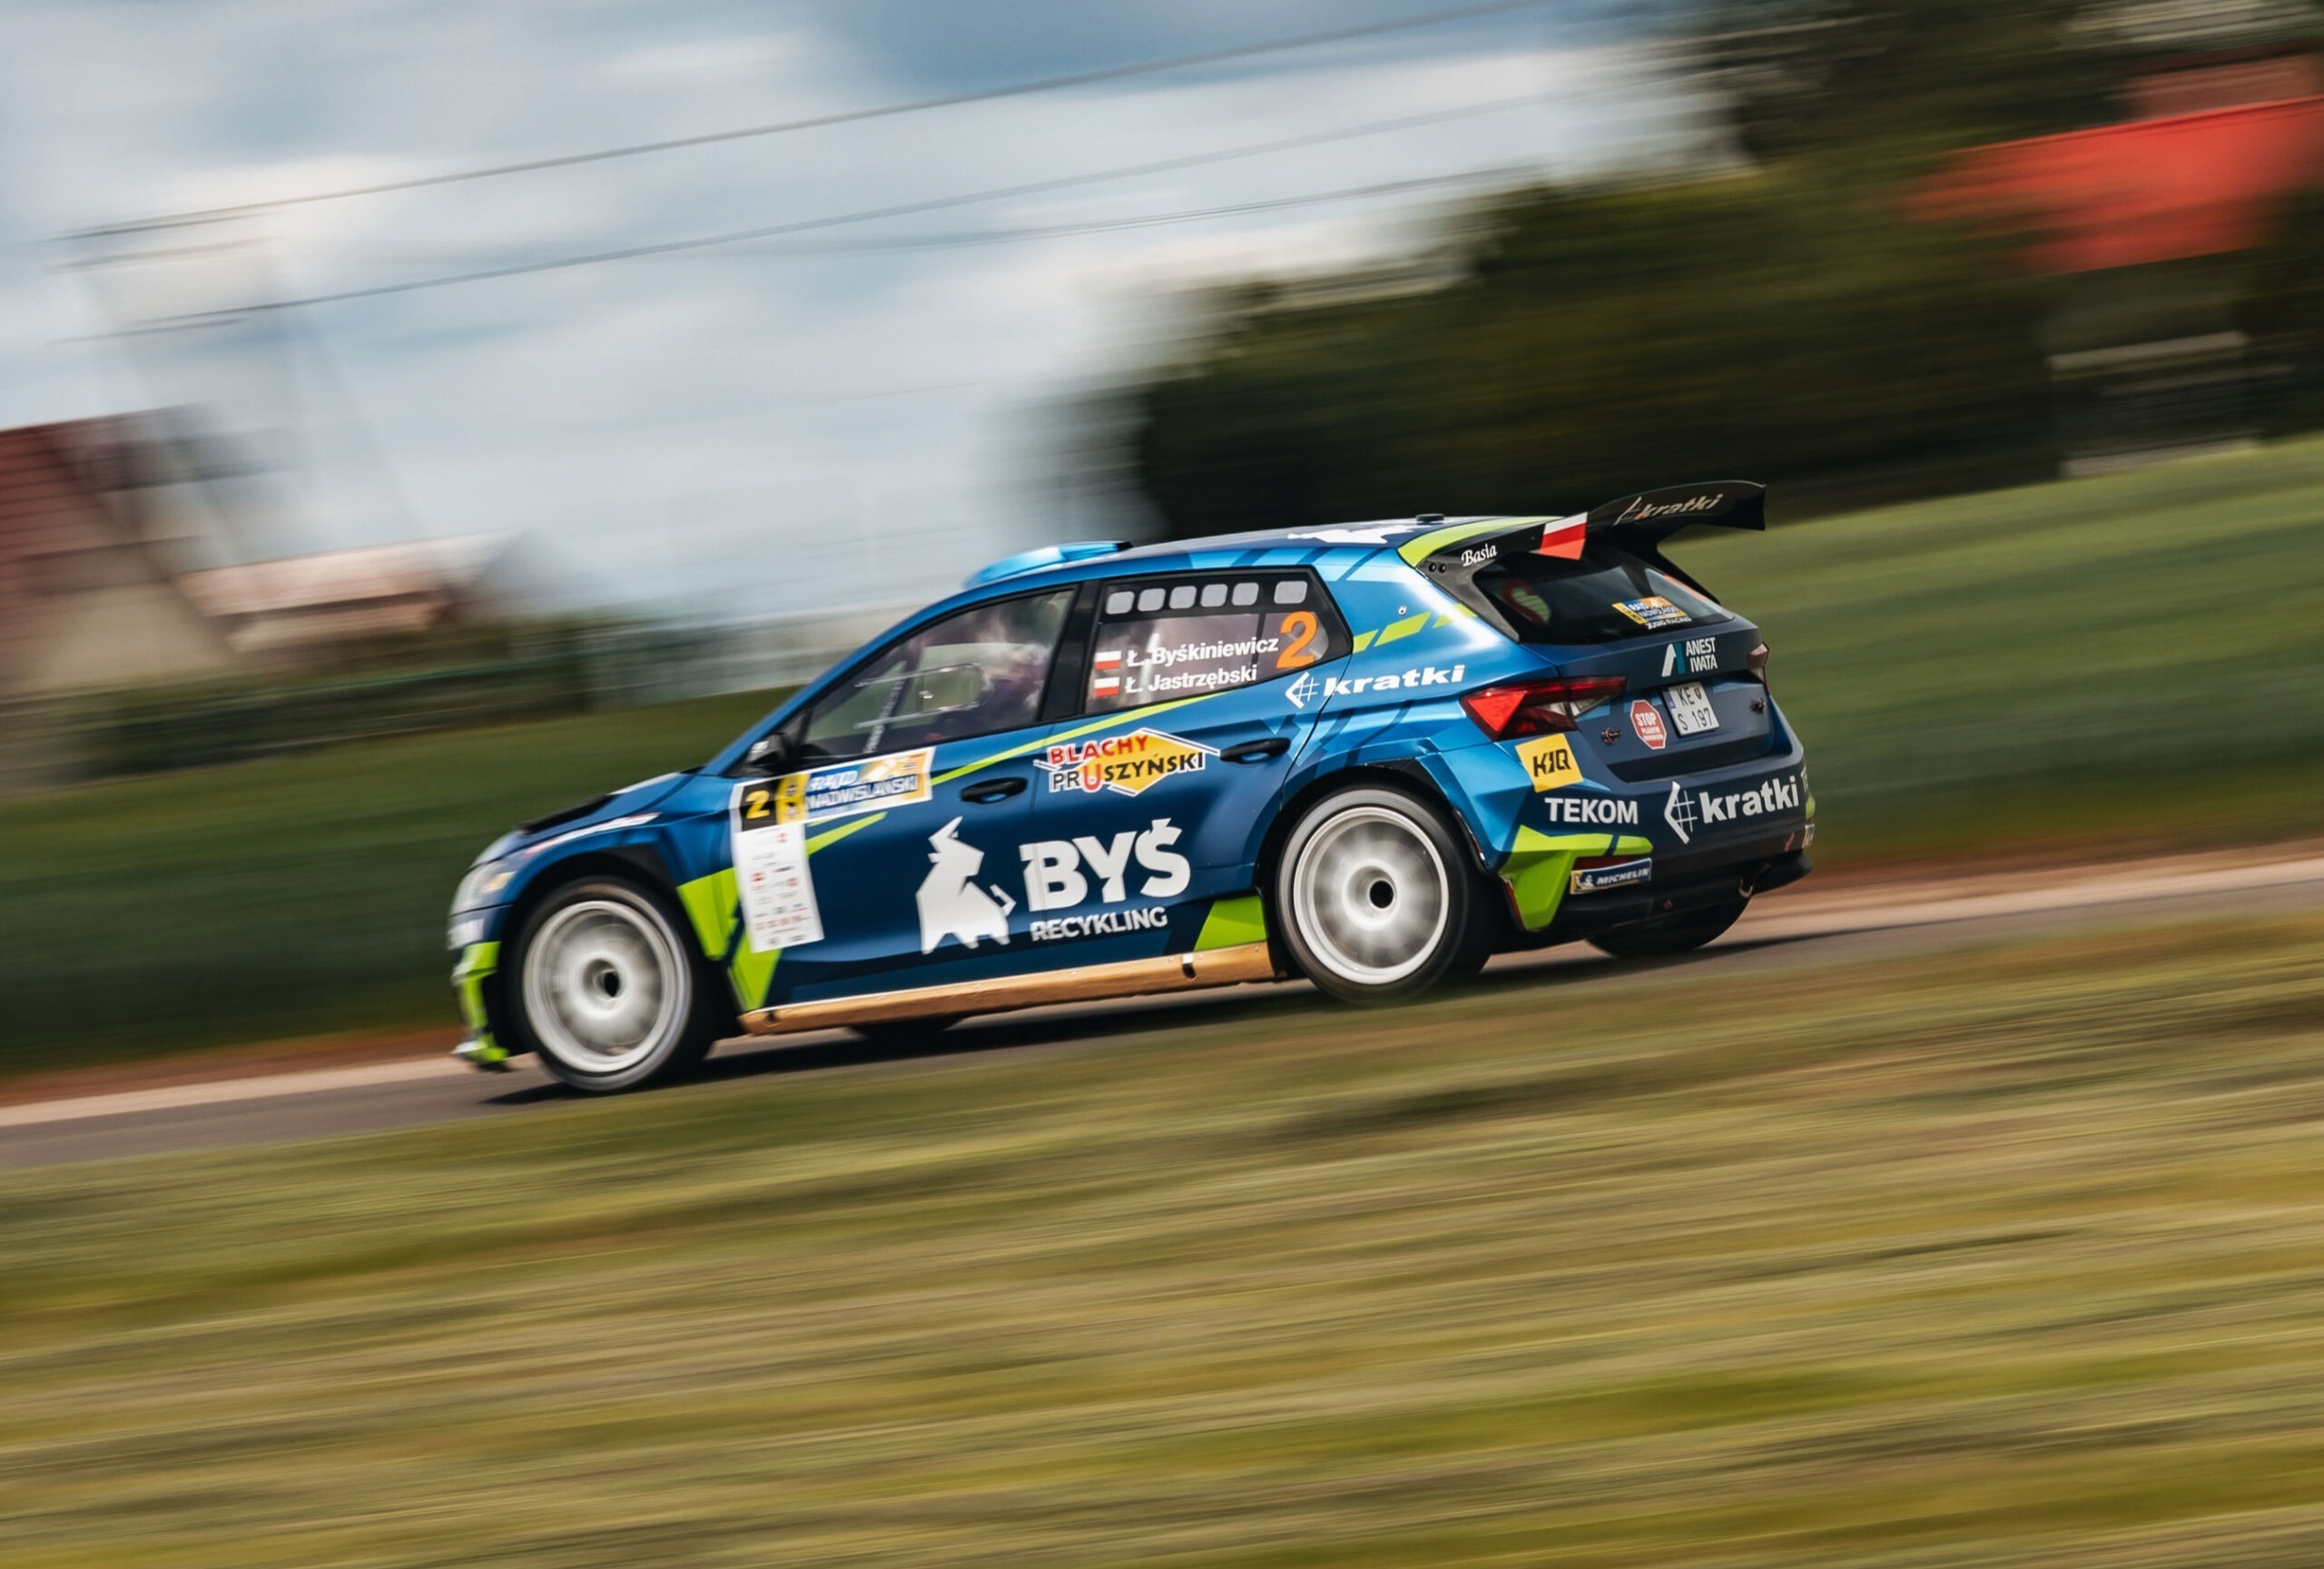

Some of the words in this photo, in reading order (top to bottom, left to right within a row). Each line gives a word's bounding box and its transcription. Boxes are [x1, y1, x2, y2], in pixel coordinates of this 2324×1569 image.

[1634, 493, 1723, 519] kratki
[1151, 636, 1279, 667] Byśkiniewicz
[1276, 610, 1317, 669] 2
[1686, 637, 1716, 657] ANEST
[1690, 653, 1718, 672] IWATA
[1148, 665, 1257, 693] Jastrzębski
[1323, 665, 1465, 697] kratki
[1677, 686, 1695, 706] KE
[1635, 712, 1657, 727] STOP
[1678, 713, 1688, 731] S
[1692, 707, 1712, 728] 197
[1049, 734, 1150, 765] BLACHY
[1050, 750, 1205, 792] PRUSZYŃSKI
[745, 790, 771, 819] 2
[1544, 797, 1639, 824] TEKOM
[1699, 775, 1799, 824] kratki
[1019, 817, 1191, 912] BYŚ
[1596, 867, 1650, 885] MICHELIN
[1029, 906, 1168, 942] RECYKLING
